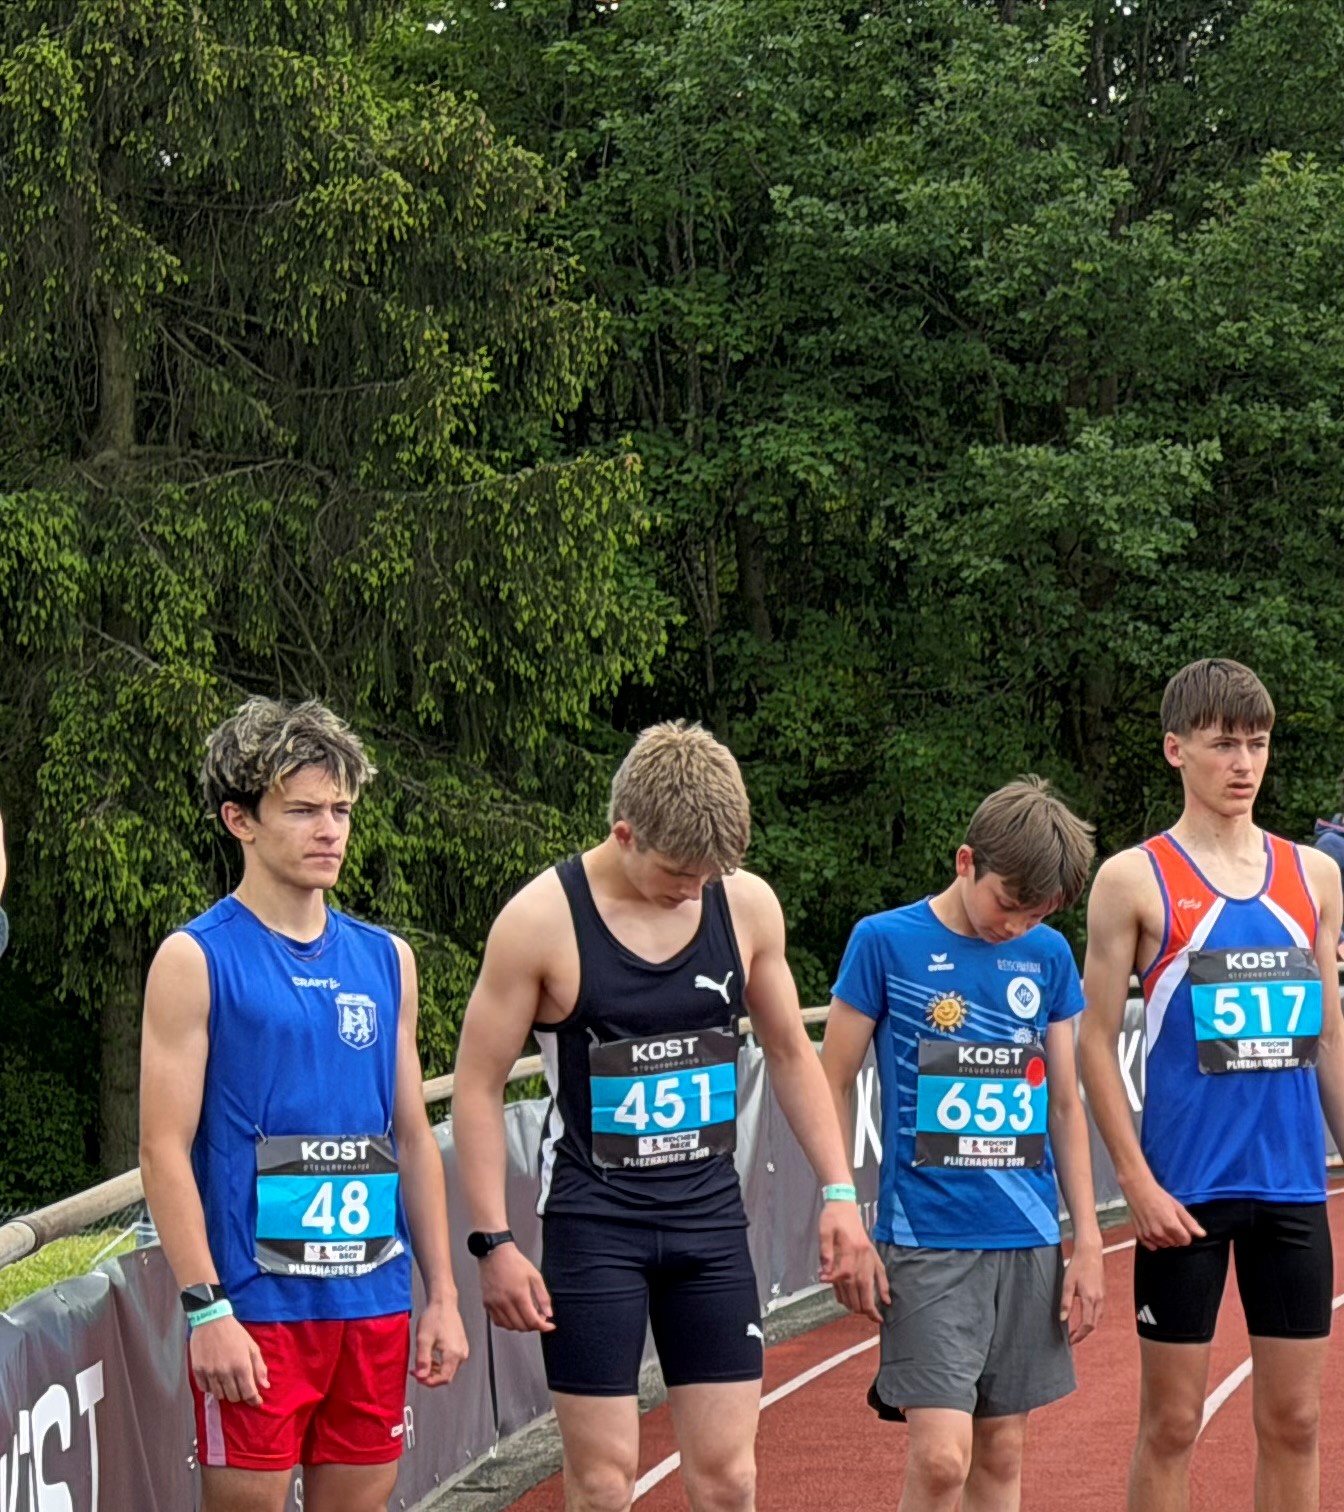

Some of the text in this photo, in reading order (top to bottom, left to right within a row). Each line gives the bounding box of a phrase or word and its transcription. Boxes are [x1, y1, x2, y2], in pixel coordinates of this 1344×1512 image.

[1226, 952, 1289, 970] KOST
[1213, 986, 1306, 1035] 517
[632, 1037, 698, 1062] KOST
[958, 1047, 1023, 1065] KOST
[614, 1073, 711, 1130] 451
[937, 1083, 1033, 1132] 653
[301, 1141, 370, 1161] KOST
[301, 1180, 370, 1235] 48
